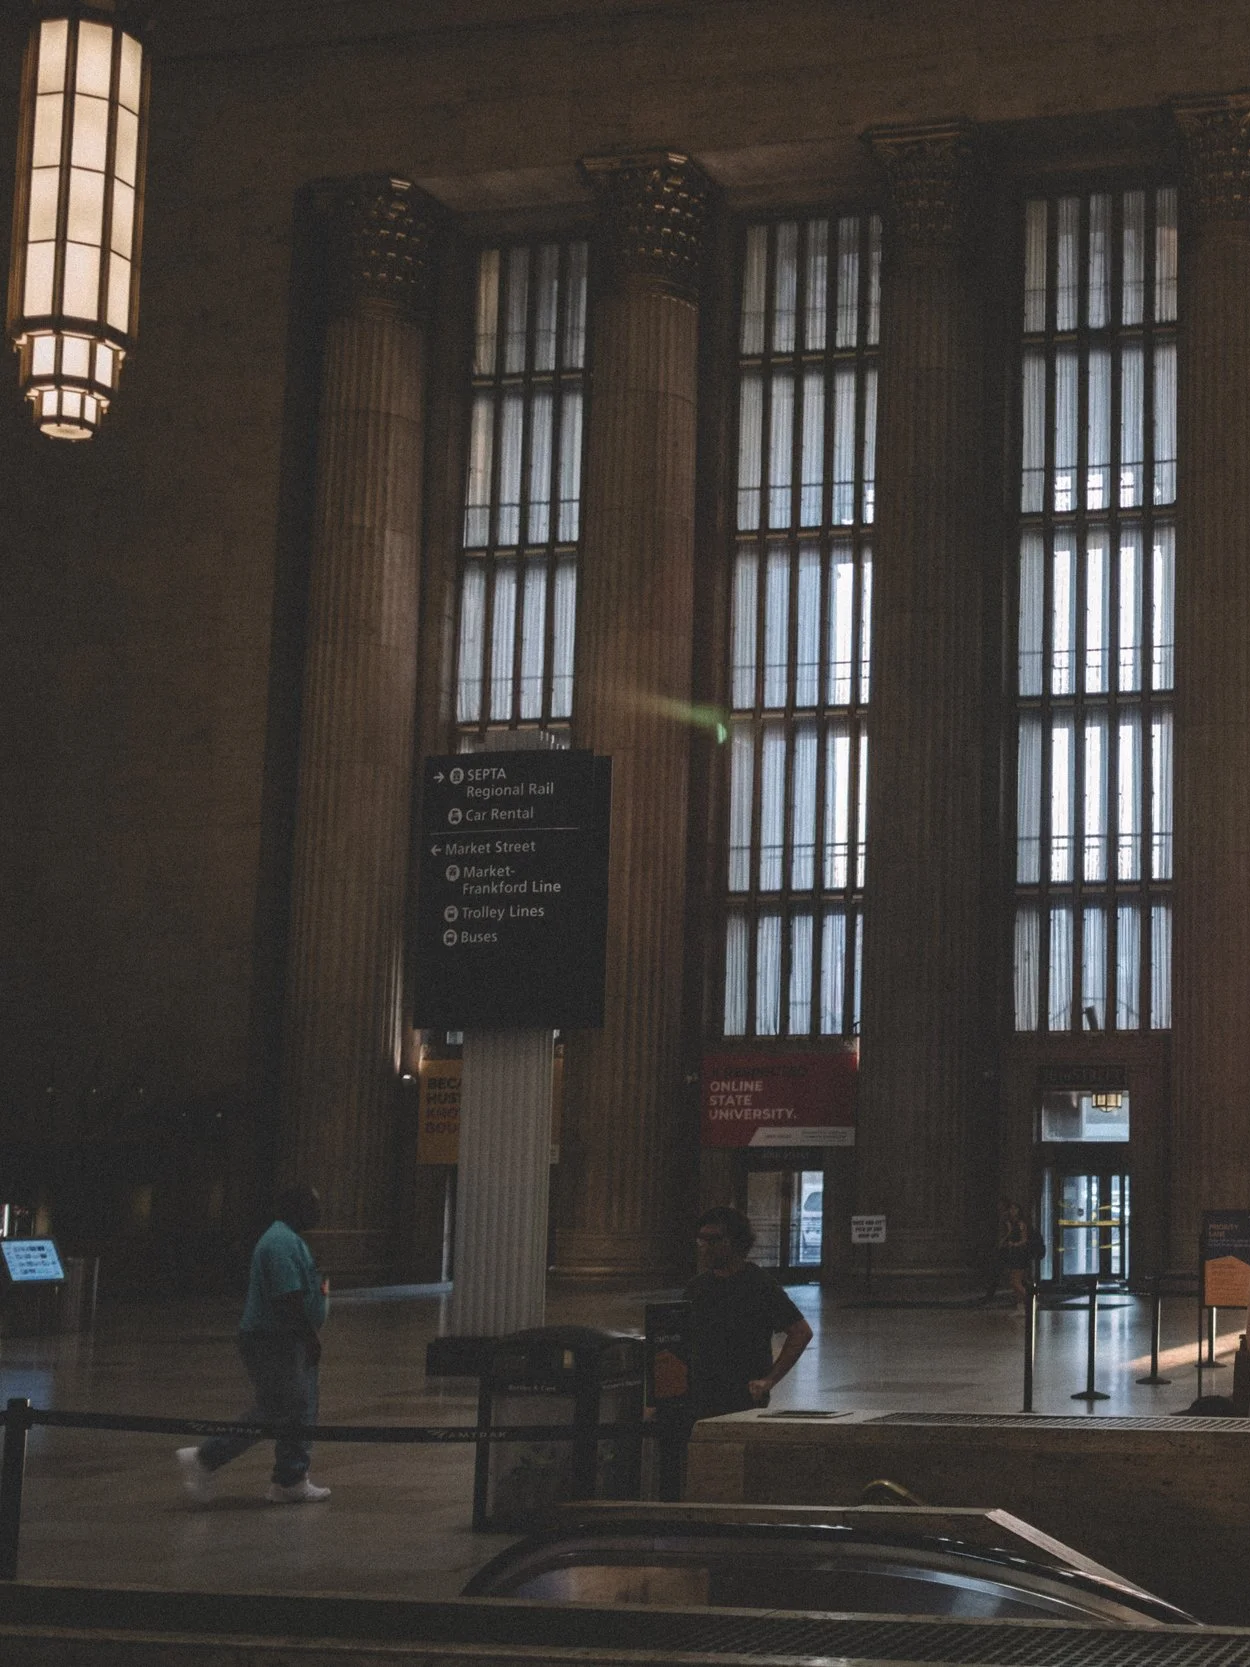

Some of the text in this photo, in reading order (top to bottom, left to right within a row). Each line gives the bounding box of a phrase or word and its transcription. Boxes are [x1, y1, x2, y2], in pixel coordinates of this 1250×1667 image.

[467, 768, 507, 781] SEPTA
[466, 782, 554, 800] Regional Rail
[465, 807, 534, 822] Car Rental
[445, 841, 536, 856] Market Street
[463, 865, 515, 879] Market-
[462, 880, 561, 895] Frankford Line
[461, 905, 545, 921] Trolley Lines
[460, 931, 498, 944] Buses
[709, 1080, 763, 1092] ONLINE
[708, 1094, 752, 1106] STATE
[708, 1108, 797, 1121] UNIVERSITY.
[206, 1424, 263, 1434] AMTRAK
[448, 1431, 506, 1440] AMTRAK
